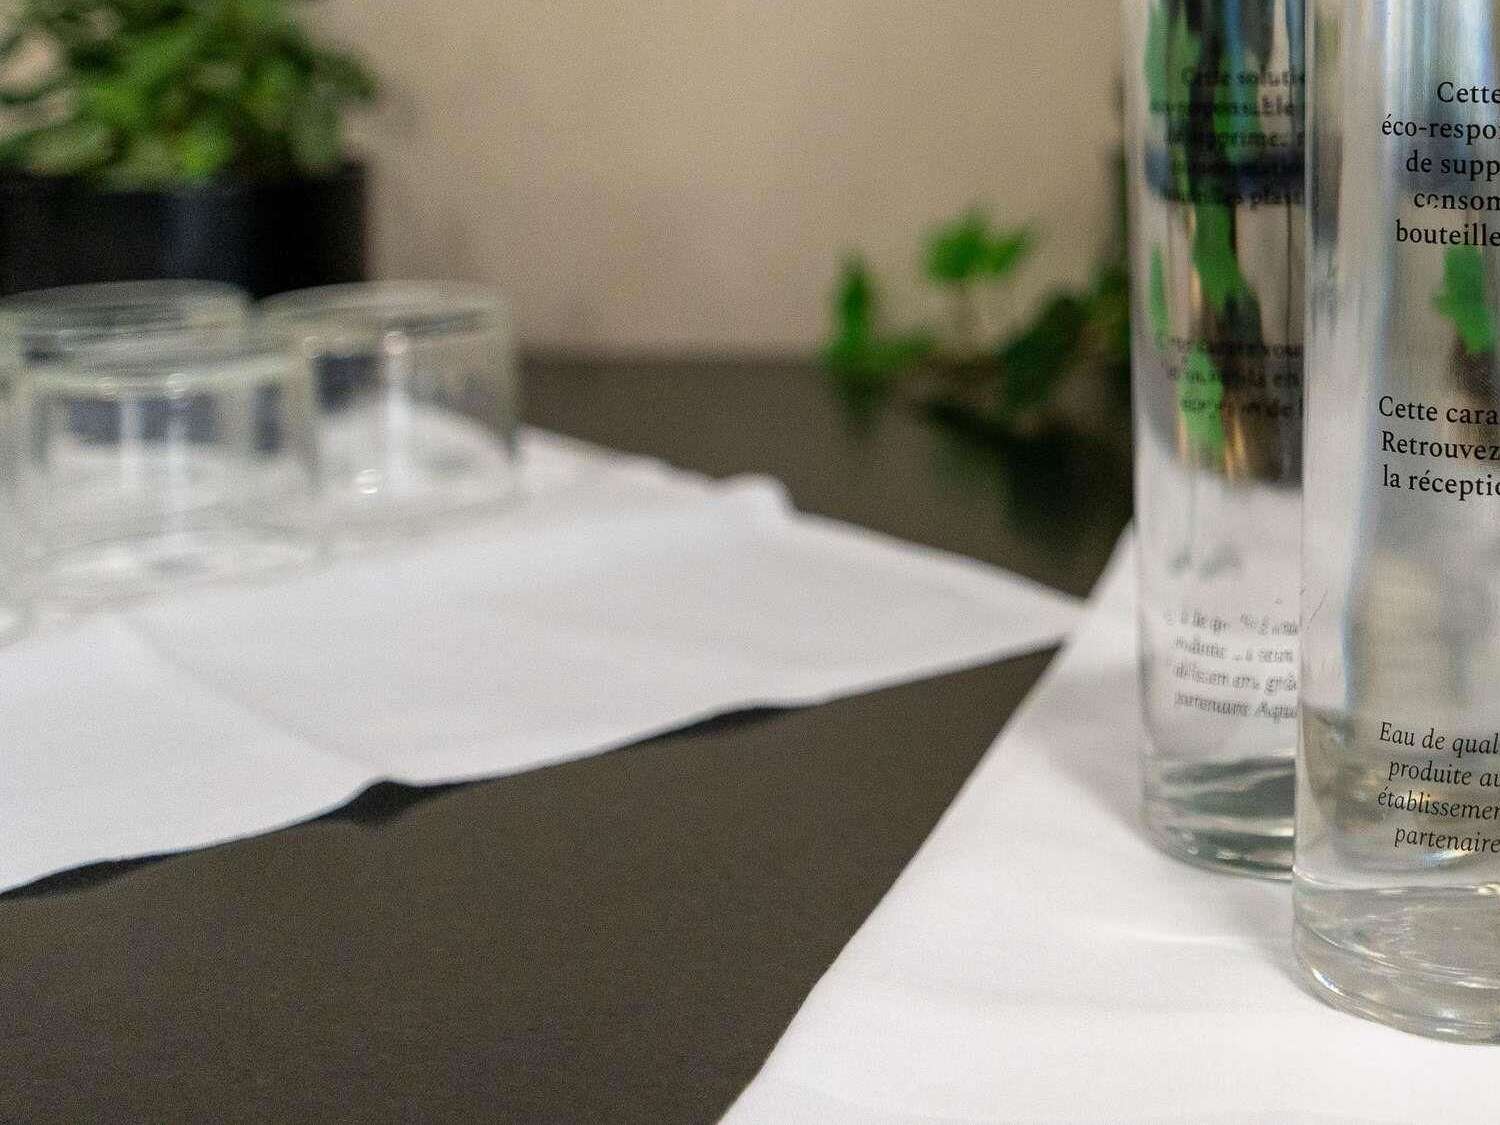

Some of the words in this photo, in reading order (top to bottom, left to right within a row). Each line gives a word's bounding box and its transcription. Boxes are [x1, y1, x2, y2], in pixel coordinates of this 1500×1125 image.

[1405, 149, 1433, 174] de
[1378, 395, 1438, 422] Cette
[1382, 464, 1402, 489] la
[1379, 721, 1416, 747] Eau
[1421, 727, 1446, 751] de
[1387, 759, 1472, 787] produite
